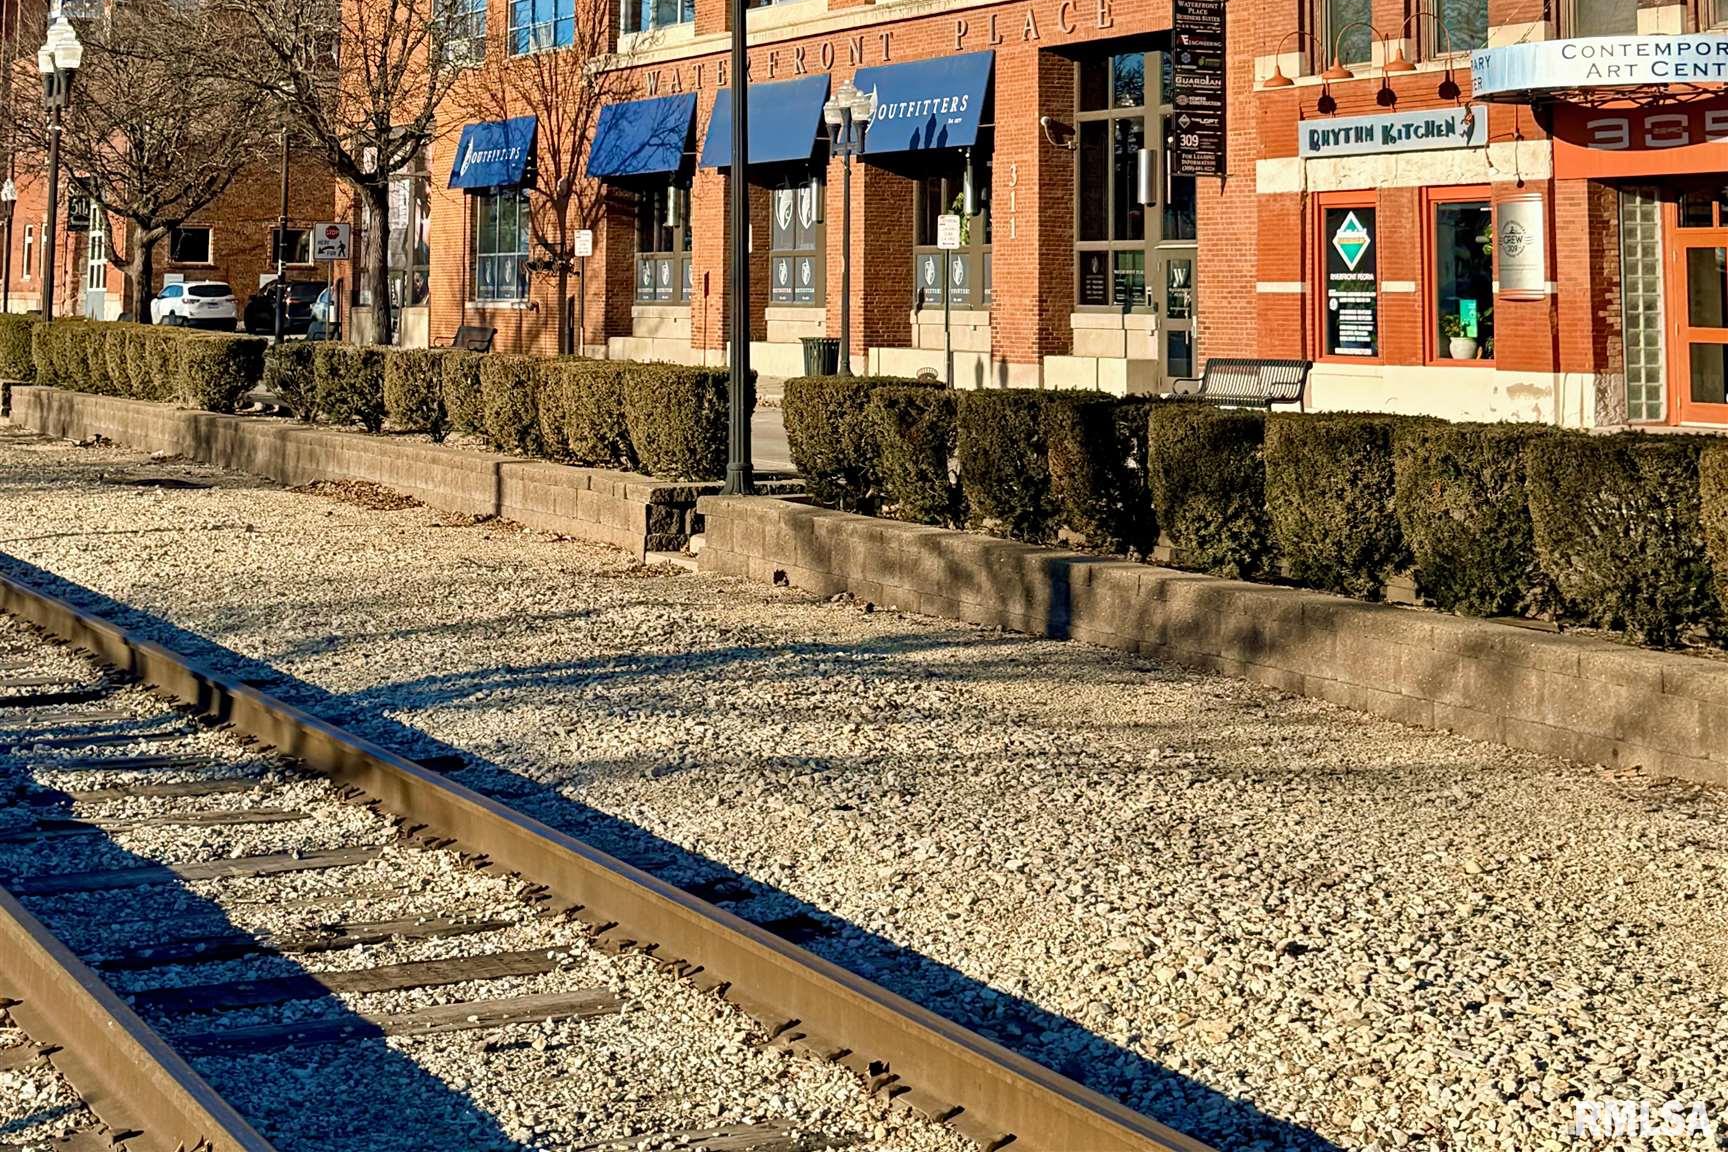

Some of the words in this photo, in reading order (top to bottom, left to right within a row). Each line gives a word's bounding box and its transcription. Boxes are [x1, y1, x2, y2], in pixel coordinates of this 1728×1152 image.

[1177, 0, 1219, 9] WATERFRONT
[1187, 8, 1209, 16] PLACE
[1586, 63, 1638, 78] ART
[1651, 61, 1727, 77] CENT
[1175, 75, 1222, 86] GUARDIAN
[878, 94, 969, 120] OUTFITTERS
[1180, 134, 1199, 146] 309
[1308, 123, 1375, 152] RHYTHM
